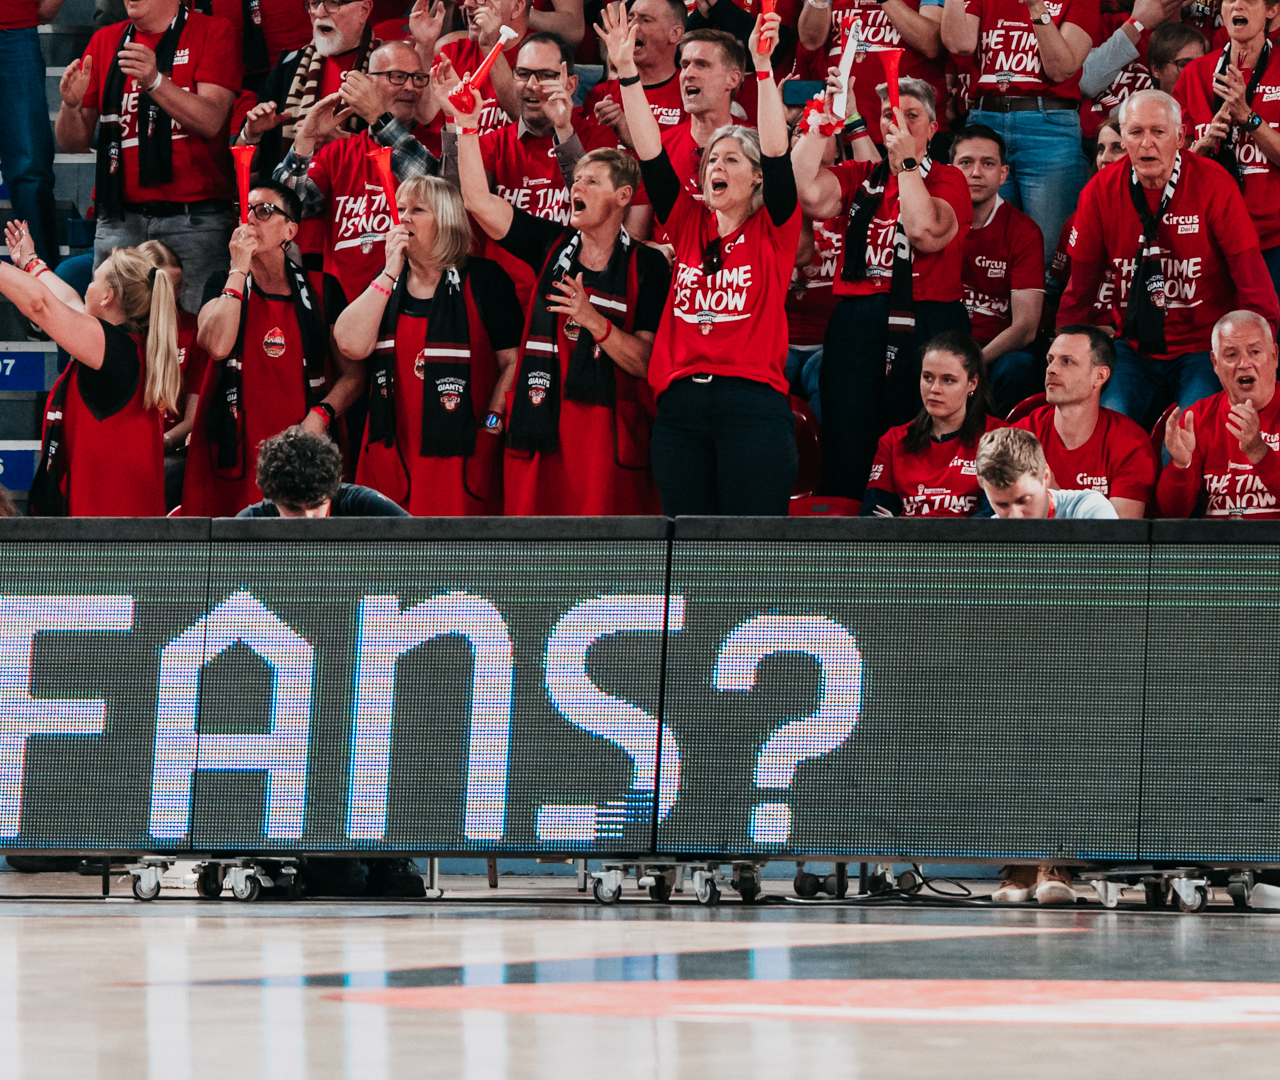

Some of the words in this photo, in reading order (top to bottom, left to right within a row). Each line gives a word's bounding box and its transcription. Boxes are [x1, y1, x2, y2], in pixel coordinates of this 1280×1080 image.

[1163, 213, 1199, 226] Circus
[1178, 225, 1199, 233] Daily
[695, 288, 746, 311] NOW
[438, 384, 463, 394] GIANTS
